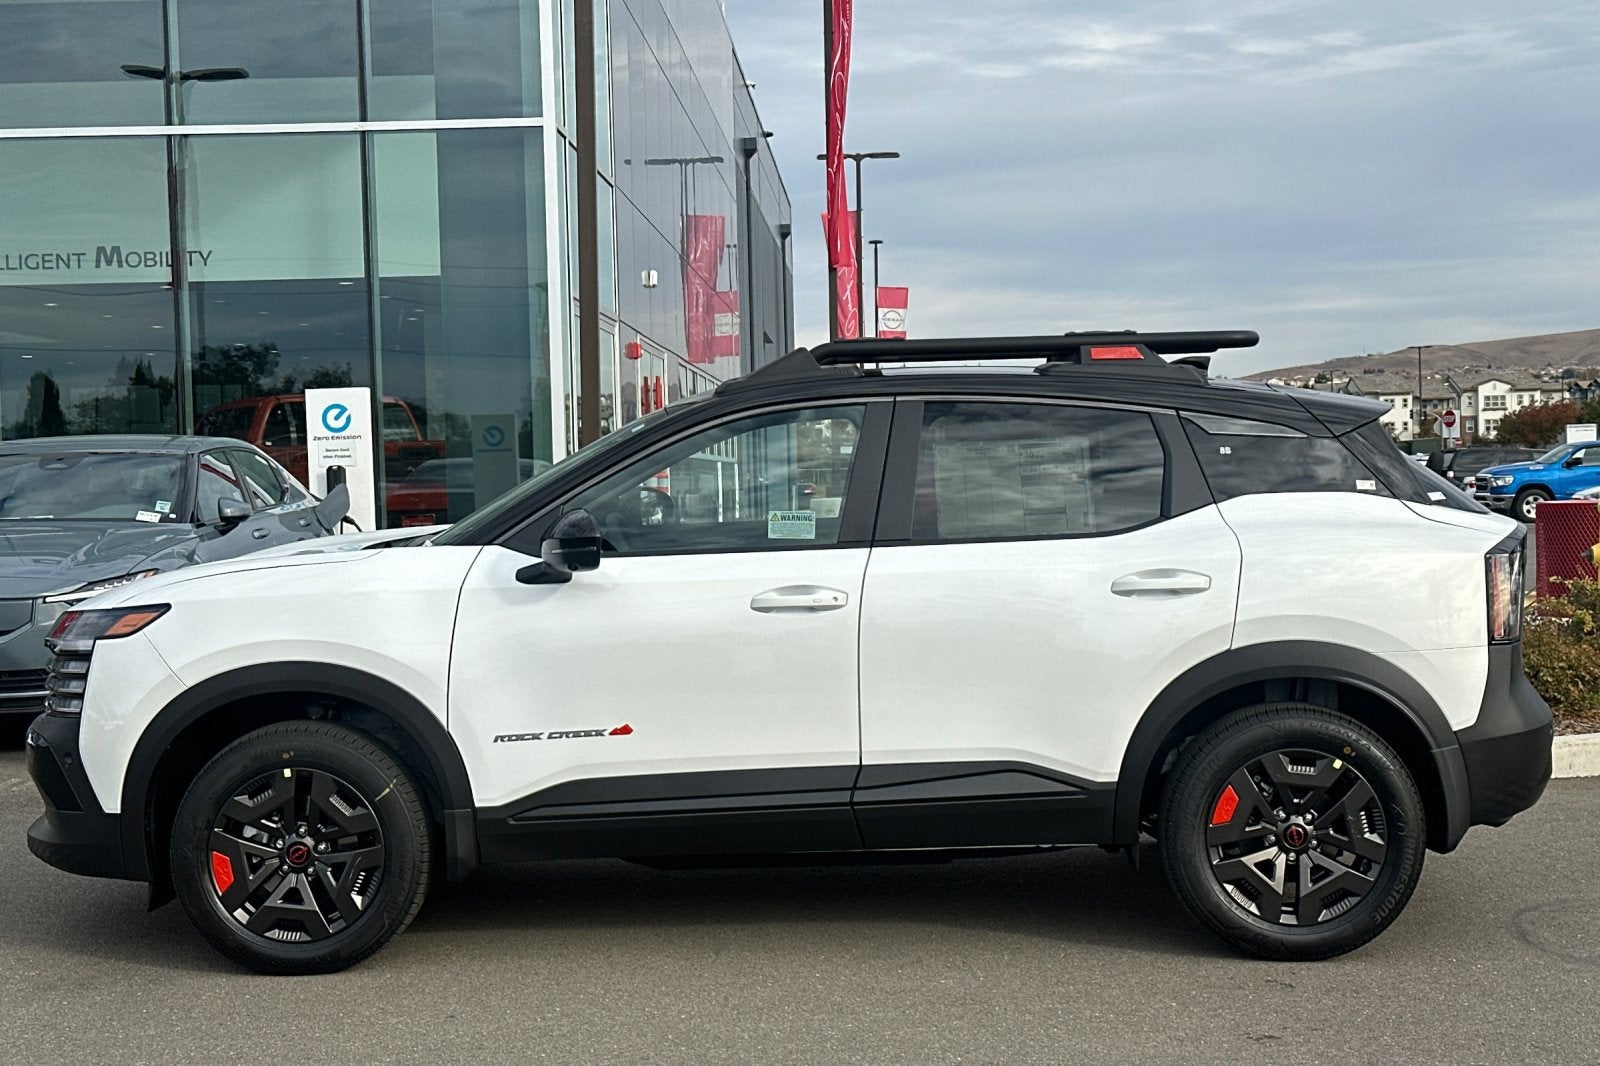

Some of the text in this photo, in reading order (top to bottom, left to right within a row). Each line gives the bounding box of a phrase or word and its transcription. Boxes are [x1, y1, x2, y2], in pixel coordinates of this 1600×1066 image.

[94, 245, 213, 269] MOBILTY
[493, 729, 609, 743] ROCK CREEK
